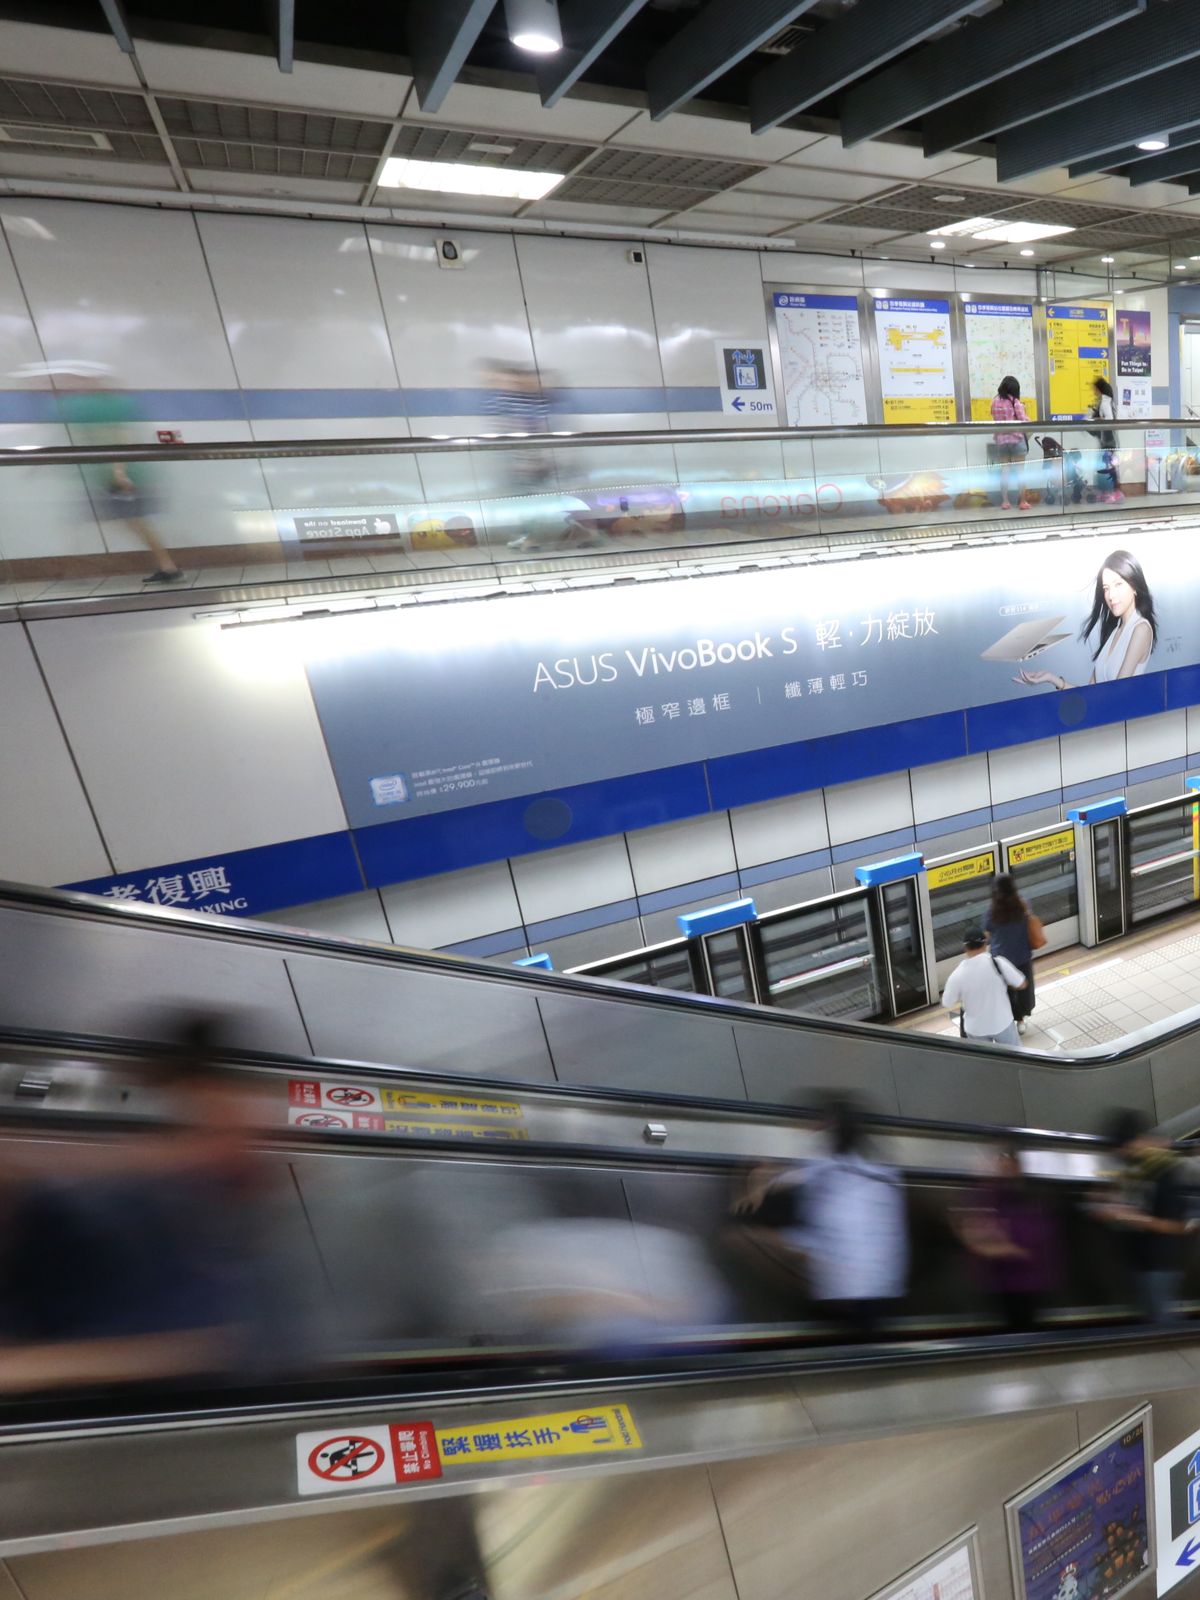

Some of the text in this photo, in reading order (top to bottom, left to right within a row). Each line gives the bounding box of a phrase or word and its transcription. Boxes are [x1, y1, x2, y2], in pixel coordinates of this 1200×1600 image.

[750, 401, 773, 411] 50m
[533, 653, 618, 693] ASUS
[625, 631, 773, 677] VivoBook
[782, 627, 799, 655] S
[635, 670, 868, 726] 極窄邊框 纖薄輕巧
[442, 1425, 561, 1458] 緊握扶手
[612, 1408, 632, 1446] Hold Handrail
[419, 1431, 430, 1459] Climbing
